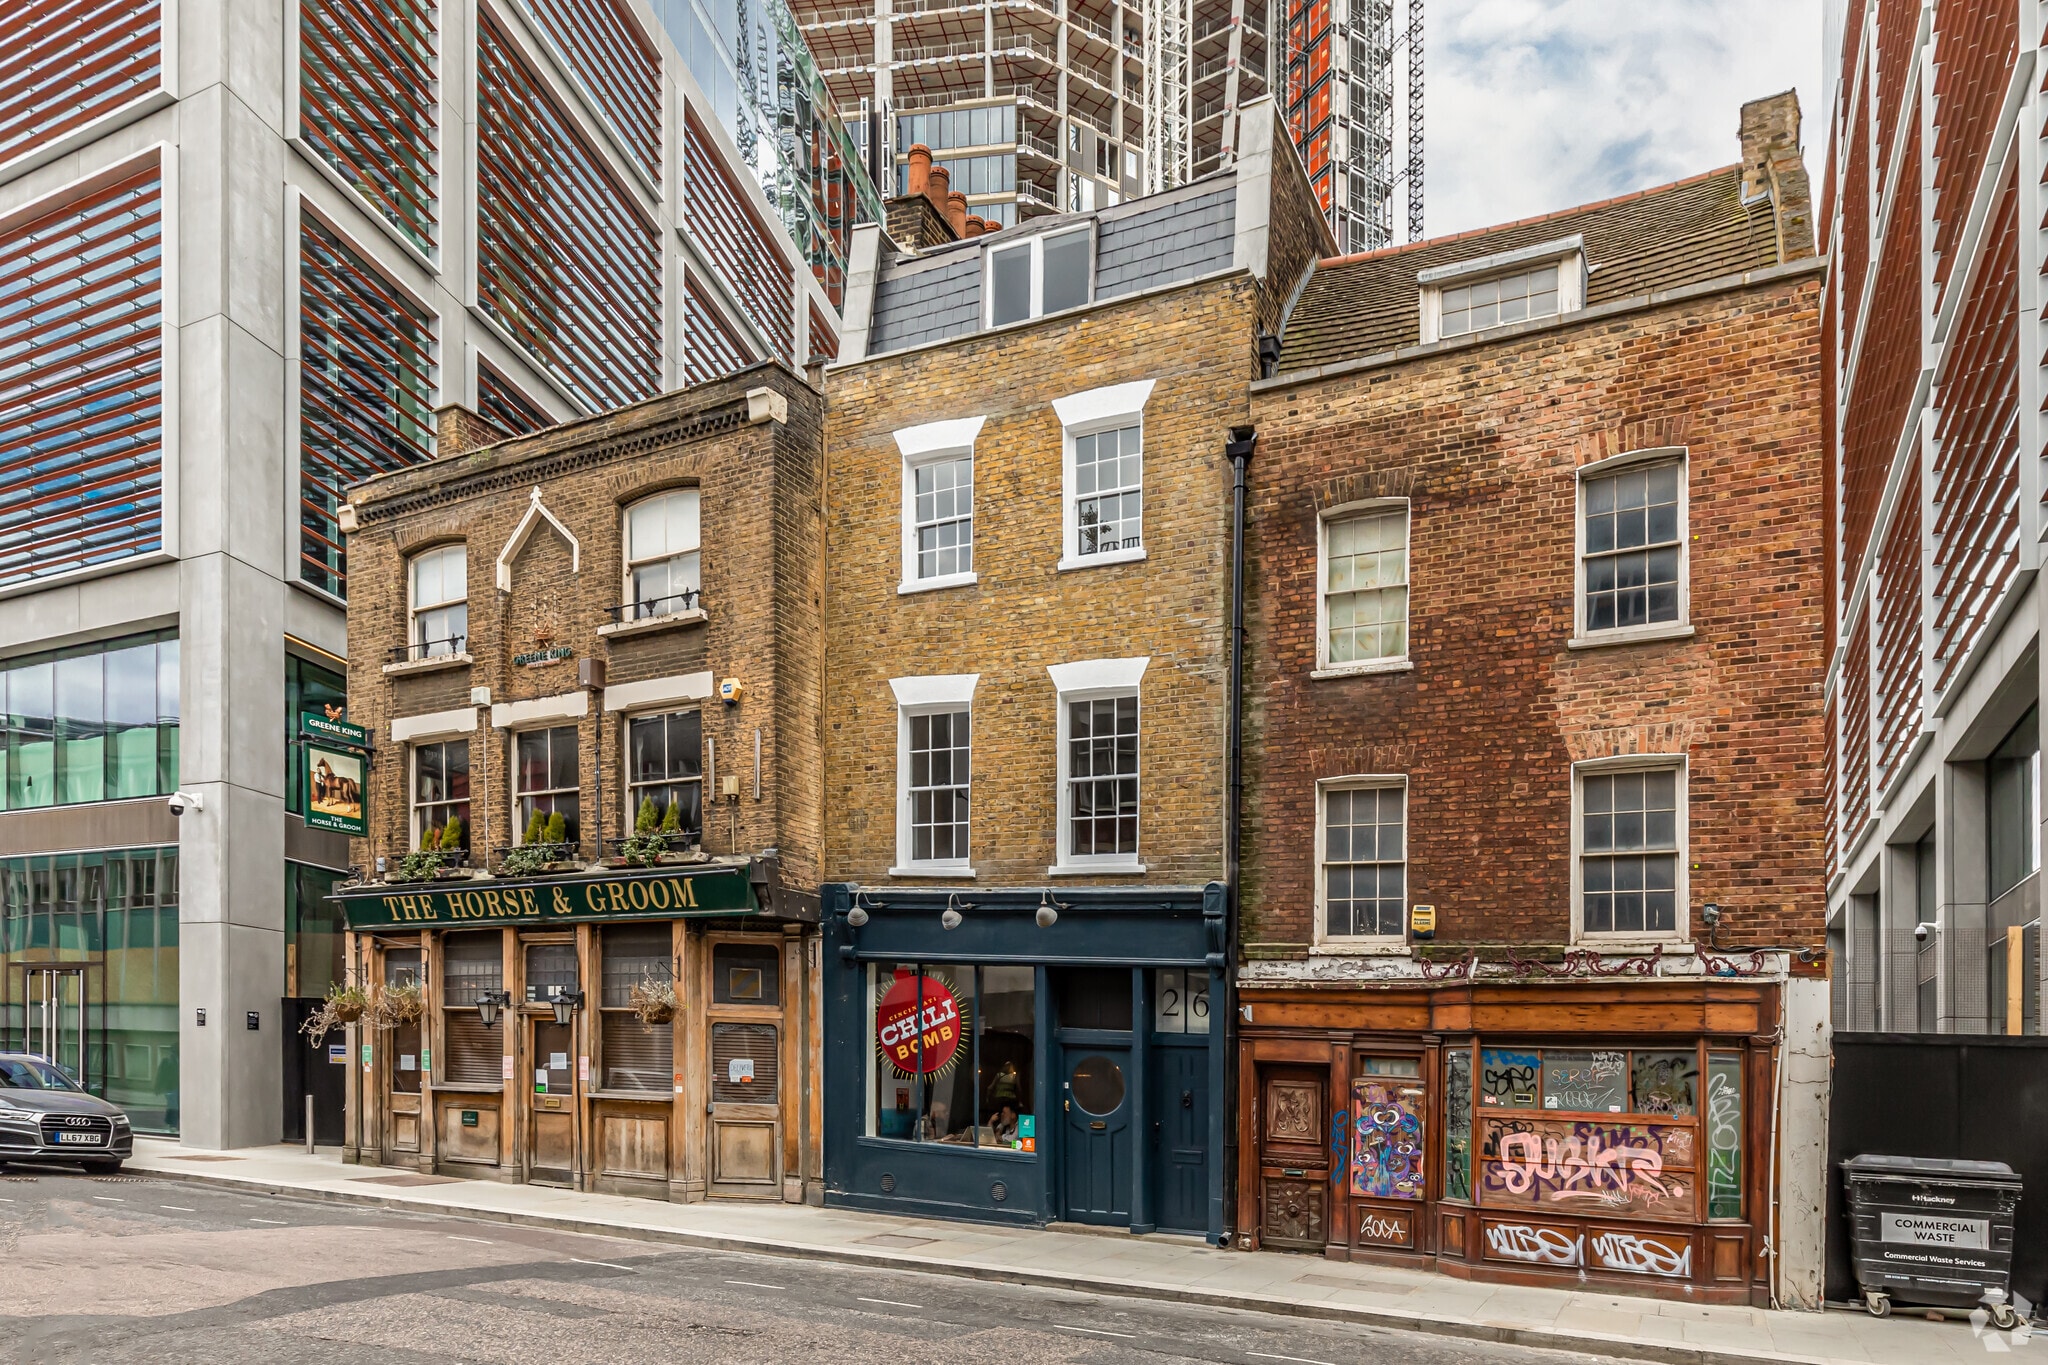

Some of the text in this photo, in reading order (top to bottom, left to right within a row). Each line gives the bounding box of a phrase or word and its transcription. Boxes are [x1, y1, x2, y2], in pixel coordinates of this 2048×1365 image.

[309, 719, 341, 732] GREENE
[341, 727, 362, 738] KING
[312, 818, 332, 826] HORSE
[338, 823, 362, 832] GROOM
[331, 815, 343, 823] THE
[382, 878, 699, 921] THE HORSE & GROOM
[880, 998, 957, 1046] CHILI
[896, 1025, 953, 1060] BOMB
[61, 1134, 83, 1142] LL67
[1895, 1219, 1976, 1233] COMMERCIAL
[1914, 1231, 1955, 1242] WASTE
[1884, 1251, 1986, 1267] Commercial Waste Services
